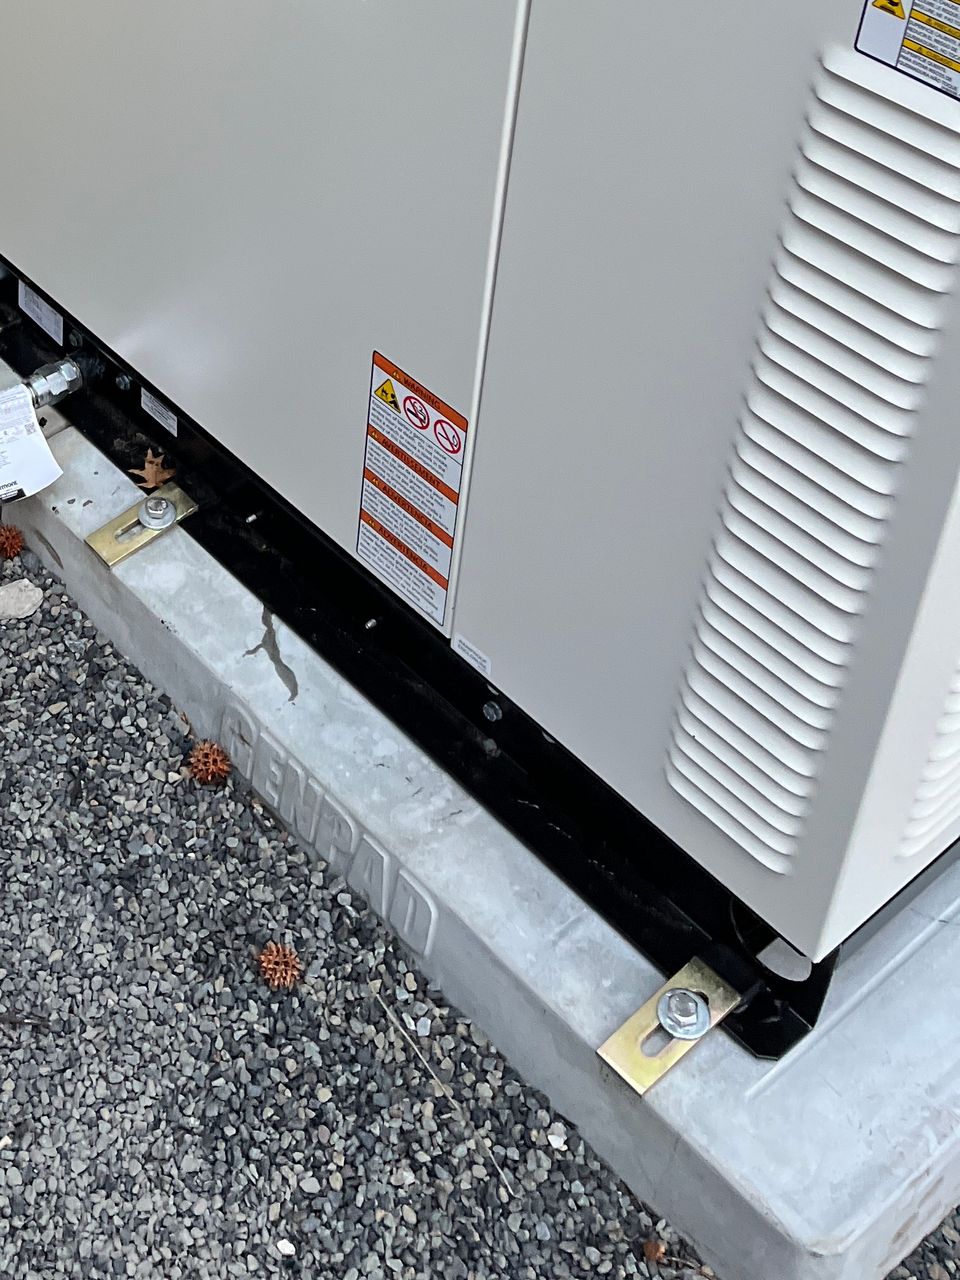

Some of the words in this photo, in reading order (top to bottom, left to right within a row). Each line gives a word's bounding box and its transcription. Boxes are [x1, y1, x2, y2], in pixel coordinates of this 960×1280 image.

[403, 377, 441, 410] WARNING
[382, 438, 441, 487] AVERTISSEMENT
[382, 485, 432, 528] ADVERTENCIA
